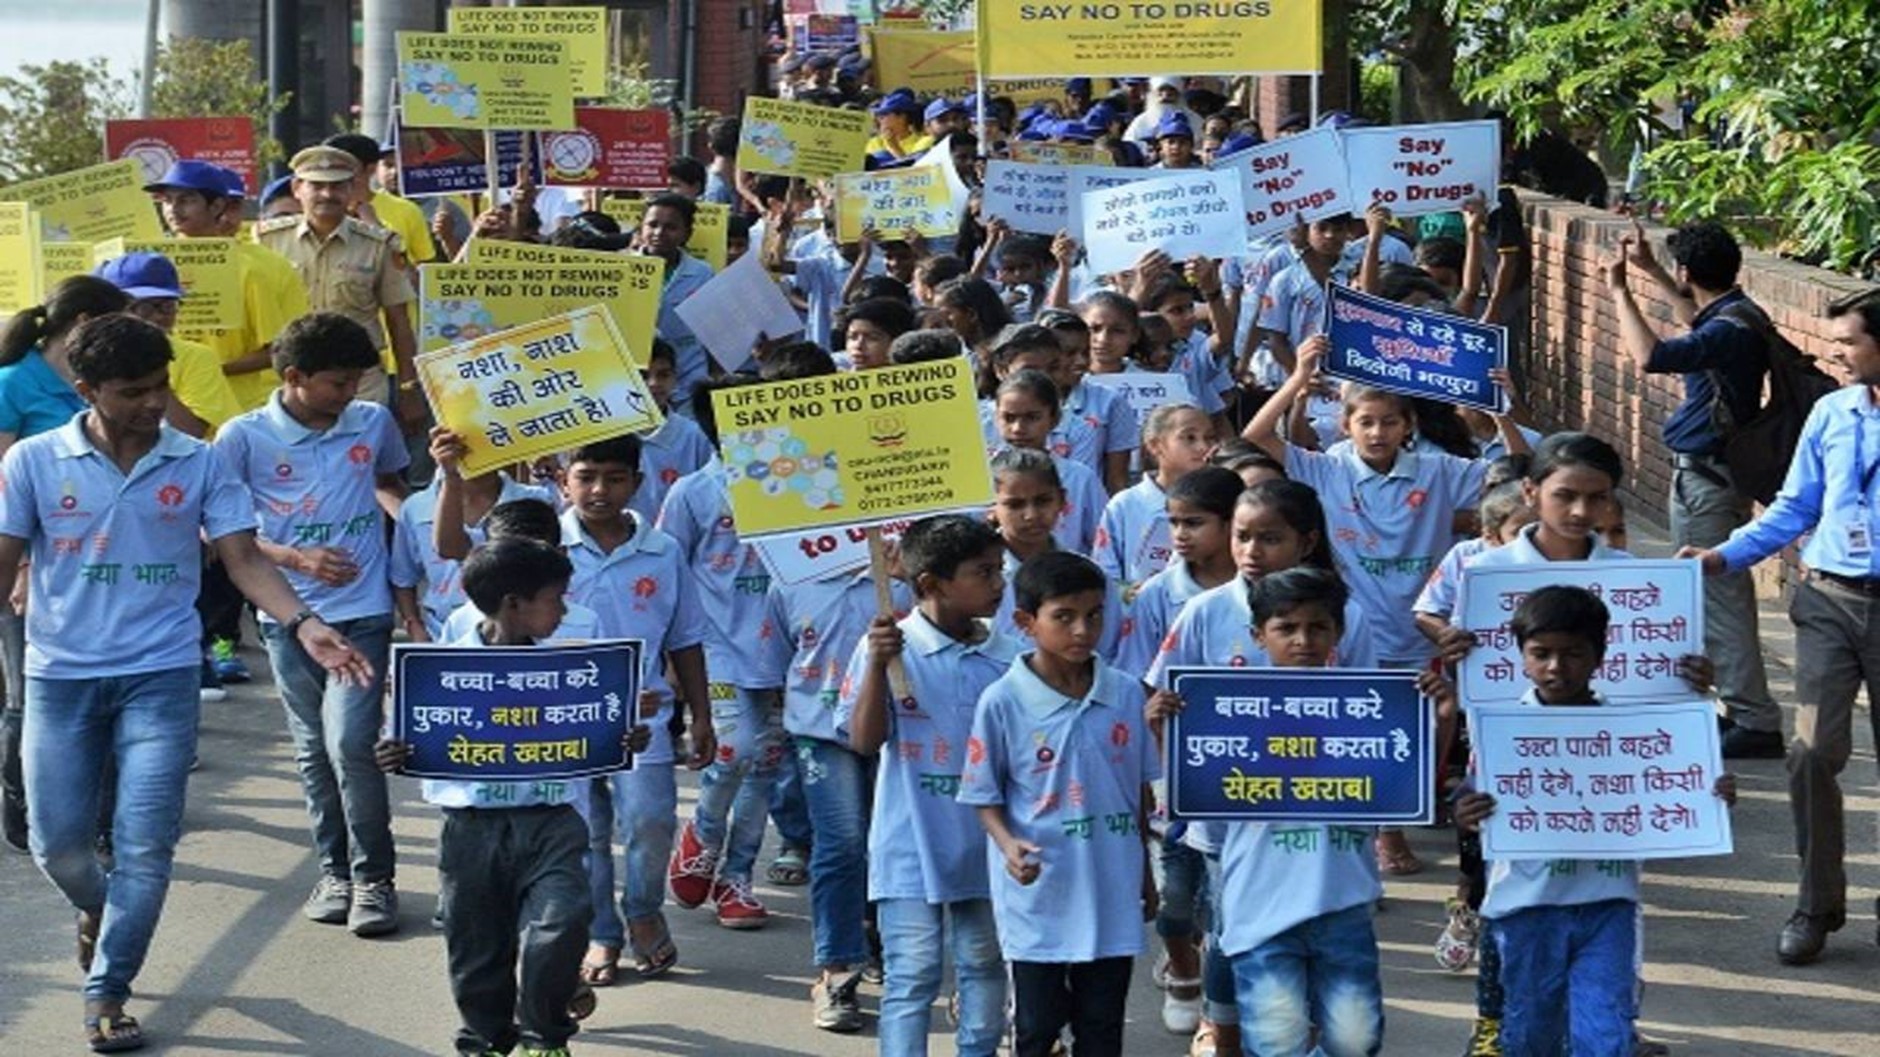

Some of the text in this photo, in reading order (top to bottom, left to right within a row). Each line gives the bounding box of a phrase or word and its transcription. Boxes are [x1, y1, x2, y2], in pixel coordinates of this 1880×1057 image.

[1021, 1, 1271, 20] SAY NO TO DRUGS
[461, 23, 596, 34] SAY NO TO DRUGS
[412, 51, 559, 64] SAY NO TO DRUGS
[1399, 137, 1446, 155] Say
[1252, 153, 1290, 173] Say
[1246, 187, 1337, 225] to Drugs
[1371, 182, 1475, 203] to Drugs
[479, 245, 510, 260] LIFE
[516, 250, 556, 264] DOES
[436, 270, 624, 282] LIFE DOES NOT REWIND
[441, 284, 620, 299] SAY NO TO DRUGS
[456, 332, 581, 380] नशा, नाश
[488, 367, 584, 409] की ओर
[726, 364, 957, 408] LIFE DOES NOT REWIND
[734, 384, 957, 427] SAY NO TO DRUGS
[485, 394, 613, 448] ले जाता है।
[799, 534, 838, 559] to
[81, 562, 123, 587] नया
[1631, 616, 1688, 643] किसी
[441, 668, 560, 693] बच्चा-बच्चा
[1484, 656, 1515, 683] को
[413, 691, 622, 733] पुकार, नशा करता है
[1215, 695, 1338, 720] बच्चा-बच्चा
[447, 733, 588, 767] सेहत खराब।
[1186, 727, 1412, 768] पुकार, नशा करता है
[1221, 766, 1374, 805] सेहत खराब।
[1642, 762, 1705, 794] किसी
[1507, 804, 1540, 834] को
